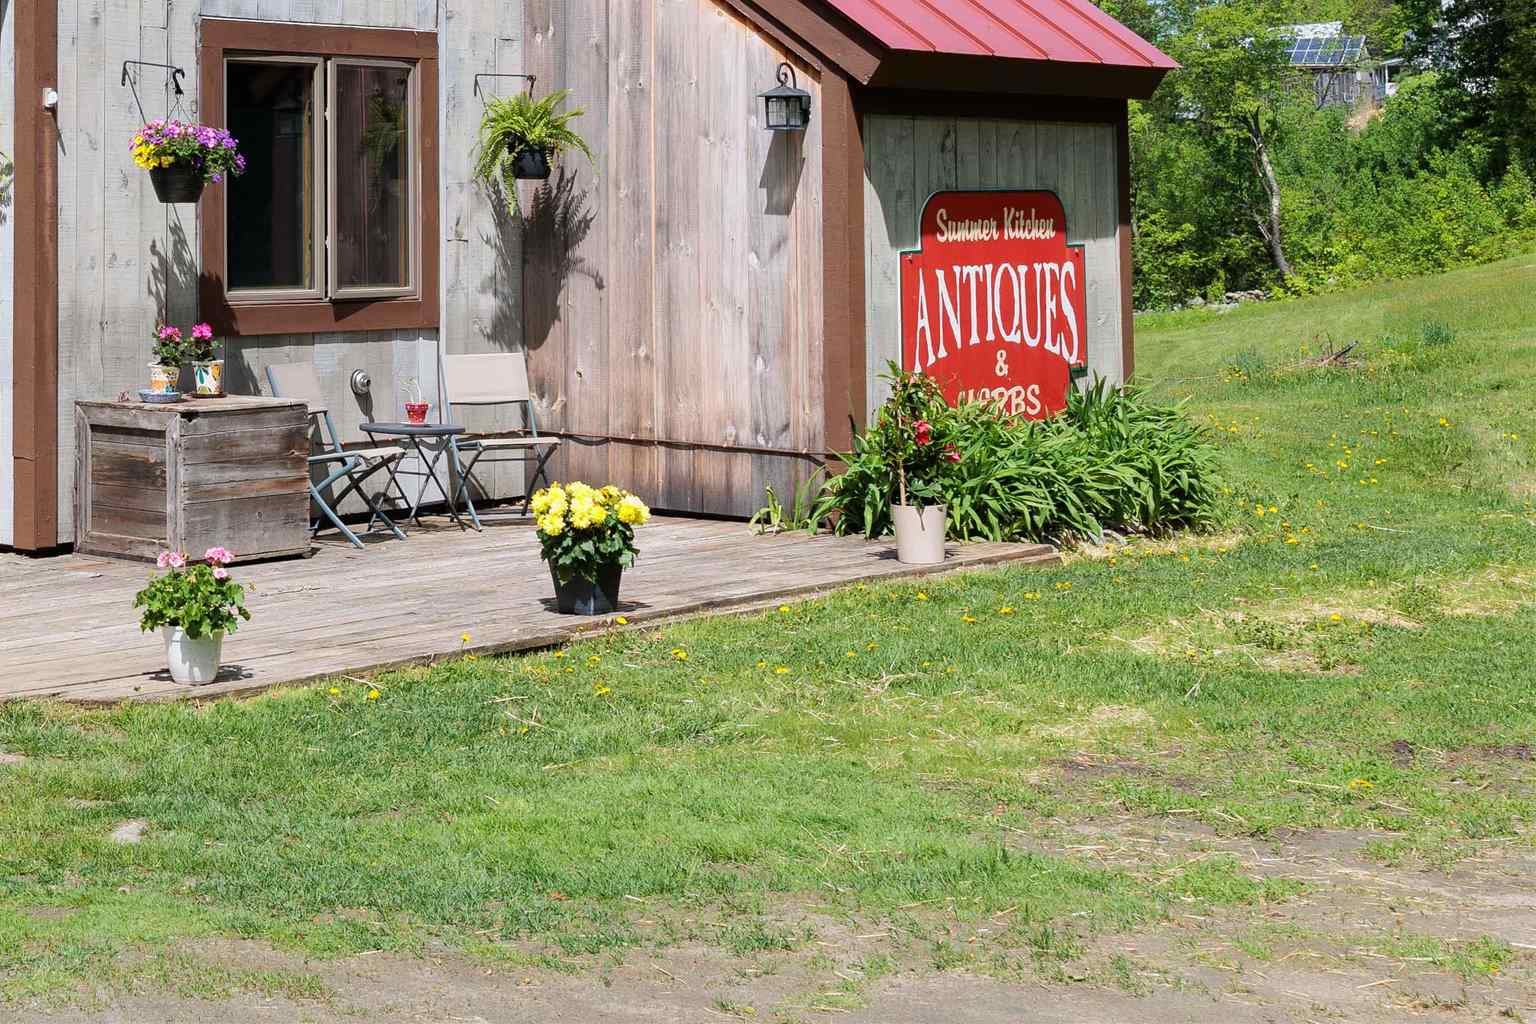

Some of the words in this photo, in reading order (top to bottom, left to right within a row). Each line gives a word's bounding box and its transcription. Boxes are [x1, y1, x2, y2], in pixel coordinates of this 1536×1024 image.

[936, 208, 1000, 243] Summer
[1003, 207, 1056, 241] Kitchen
[914, 261, 1078, 374] ANTIQUES
[994, 349, 1008, 376] &
